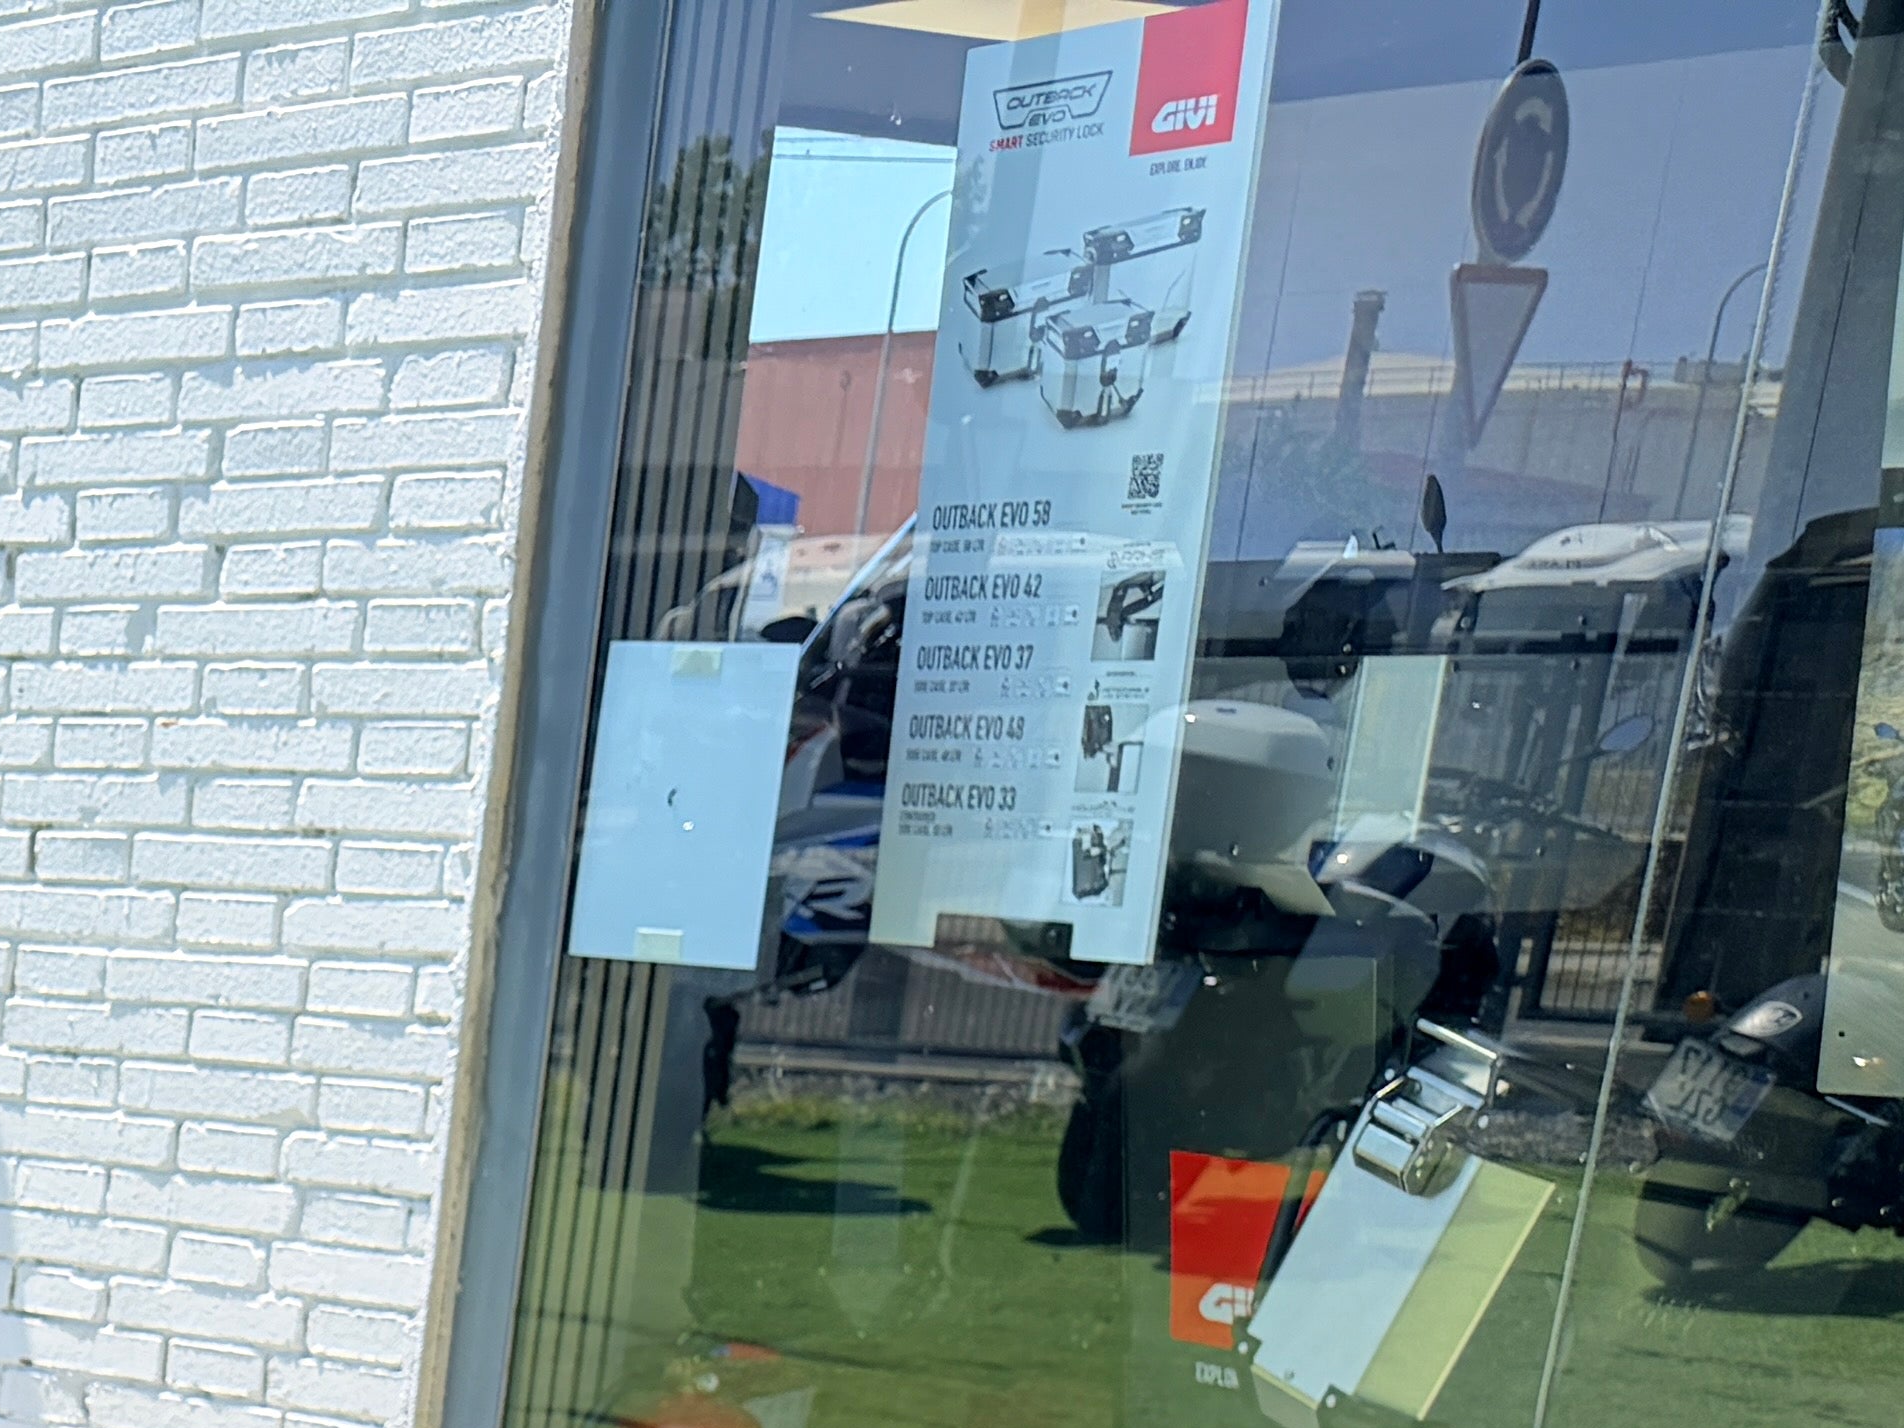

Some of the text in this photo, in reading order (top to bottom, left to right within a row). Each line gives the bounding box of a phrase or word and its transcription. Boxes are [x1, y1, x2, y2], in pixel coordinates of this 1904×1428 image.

[1007, 84, 1097, 111] OUTBACK
[1028, 109, 1067, 127] EVO
[1150, 94, 1218, 134] GIVI
[988, 122, 1106, 152] SMART SECURITY LOCK
[932, 499, 1052, 531] OUTBACK EVO 58
[924, 573, 1043, 602] OUTBACK EVO 42
[916, 644, 1035, 671] OUTBACK EVO 37
[909, 714, 971, 740] OUTBACK
[975, 715, 1004, 740] EVO
[901, 782, 1017, 812] OUTBACK EVO 33
